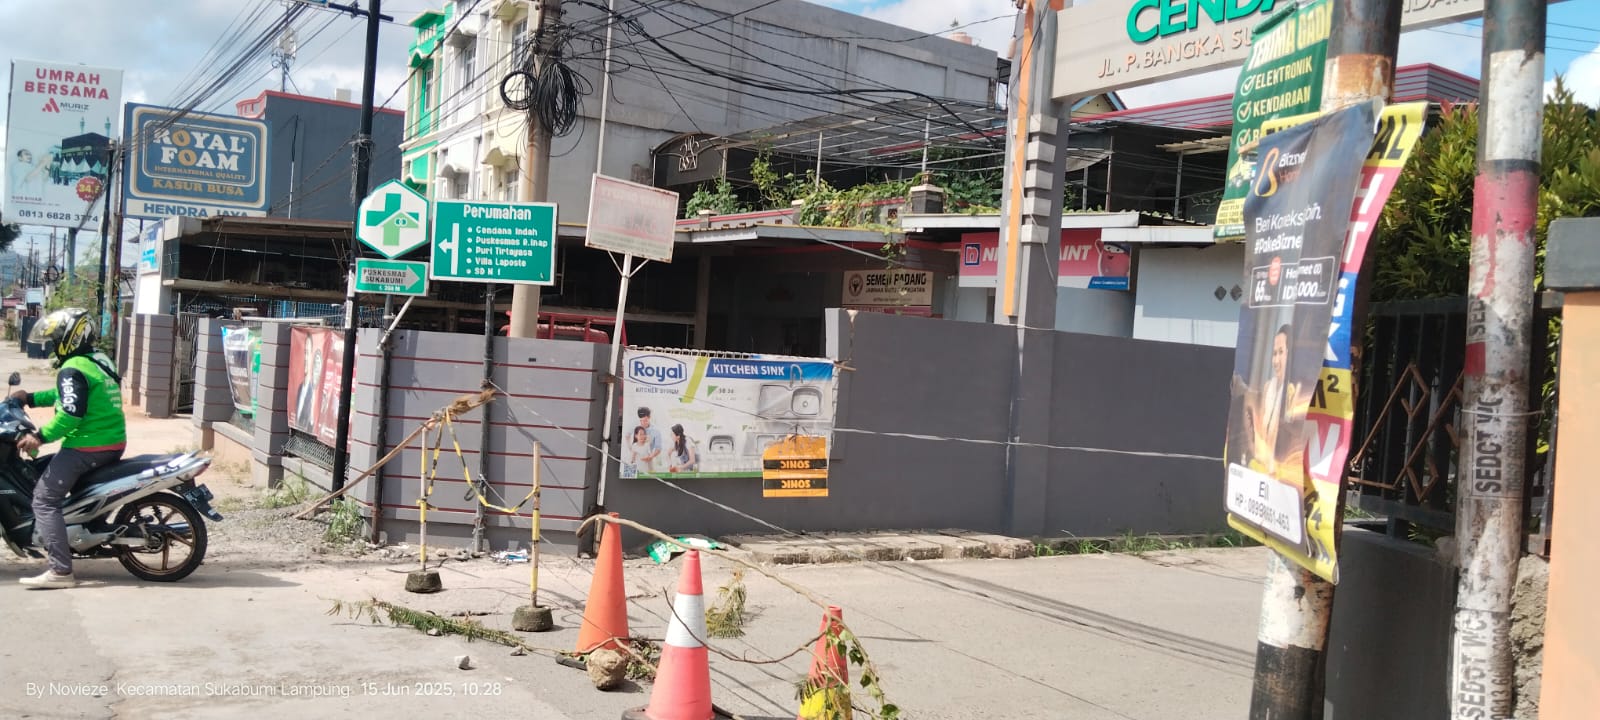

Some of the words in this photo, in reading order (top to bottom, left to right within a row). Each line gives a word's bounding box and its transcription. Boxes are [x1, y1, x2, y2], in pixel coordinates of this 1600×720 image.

[1143, 34, 1225, 68] BANGKA
[36, 67, 100, 85] UMRAH
[1254, 55, 1313, 90] ELEKTRONIK
[24, 81, 109, 100] BERSAMA
[1252, 85, 1312, 118] KENDARAAN
[153, 127, 245, 154] ROYAL
[161, 146, 239, 171] FOAM
[152, 178, 203, 192] KASUR
[207, 184, 244, 196] BUSA
[19, 209, 43, 219] 0813
[46, 212, 71, 220] 6828
[143, 202, 209, 218] HENDRA
[463, 204, 532, 220] Perumahan
[475, 226, 512, 235] Cendana
[515, 227, 538, 236] Indah
[475, 236, 520, 246] Puskesmas
[475, 246, 493, 255] Puri
[495, 247, 533, 257] Tirtayasa
[475, 257, 493, 266] Villa
[495, 258, 527, 268] Laposte
[363, 269, 407, 278] PUSKESMAS
[365, 276, 404, 284] SUKABUMI
[634, 361, 683, 382] Royal
[713, 364, 759, 375] KITCHEN
[761, 364, 785, 376] SINK
[61, 377, 78, 413] gojek
[780, 460, 811, 469] SONIC
[781, 479, 812, 489] SONIC
